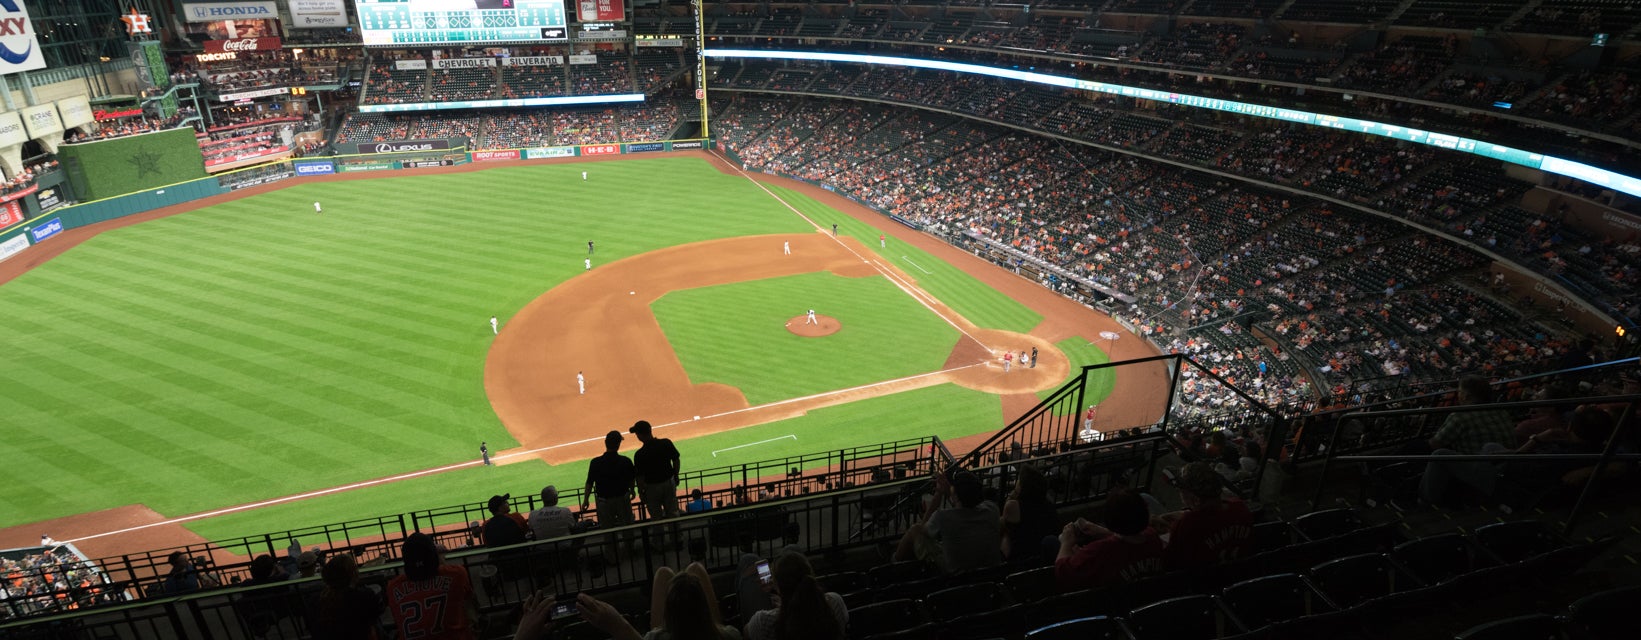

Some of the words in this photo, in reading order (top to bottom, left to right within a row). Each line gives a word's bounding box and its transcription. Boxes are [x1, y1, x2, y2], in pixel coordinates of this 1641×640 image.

[210, 6, 270, 16] HONDA
[438, 58, 491, 68] CHEVROLET
[509, 56, 558, 66] SILVERADO
[393, 143, 432, 151] LEXUS
[587, 145, 614, 153] H-E-B
[298, 165, 332, 173] GEICO
[393, 576, 453, 601] ALTUVE
[400, 592, 448, 640] 27
